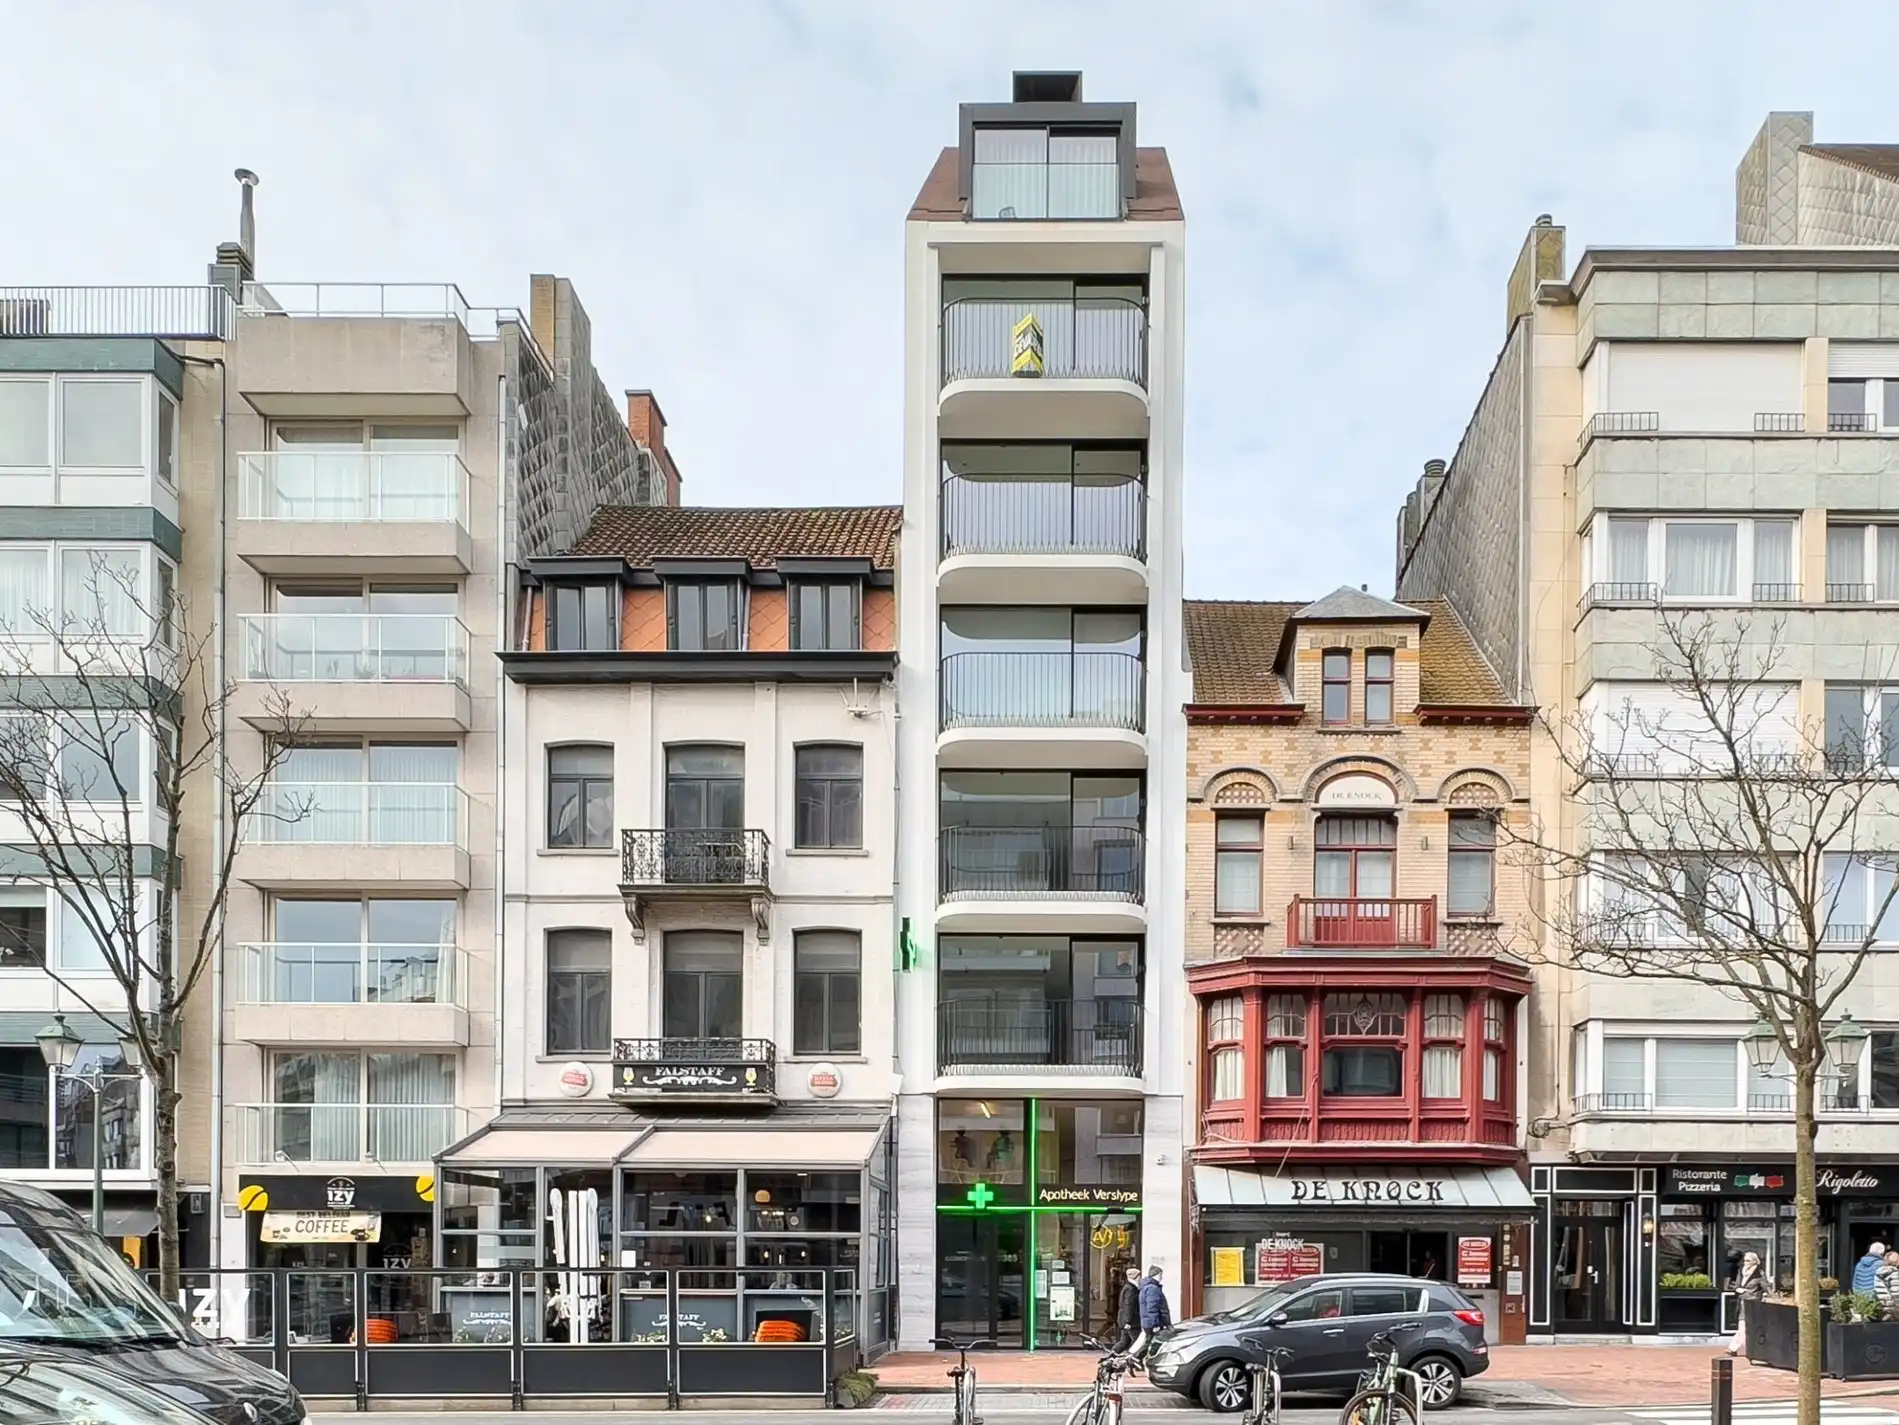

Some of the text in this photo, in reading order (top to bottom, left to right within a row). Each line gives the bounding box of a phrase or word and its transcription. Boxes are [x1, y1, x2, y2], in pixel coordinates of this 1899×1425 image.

[655, 1066, 726, 1076] FALSTAFF
[1672, 1169, 1728, 1180] Ristorante
[1678, 1181, 1721, 1192] Pizzeria
[1816, 1168, 1880, 1194] Rigoletto
[1039, 1188, 1138, 1203] Apotheek Verslype
[1291, 1180, 1327, 1200] DE
[295, 1220, 349, 1233] COFFEE
[1261, 1238, 1304, 1250] DE KNOCK
